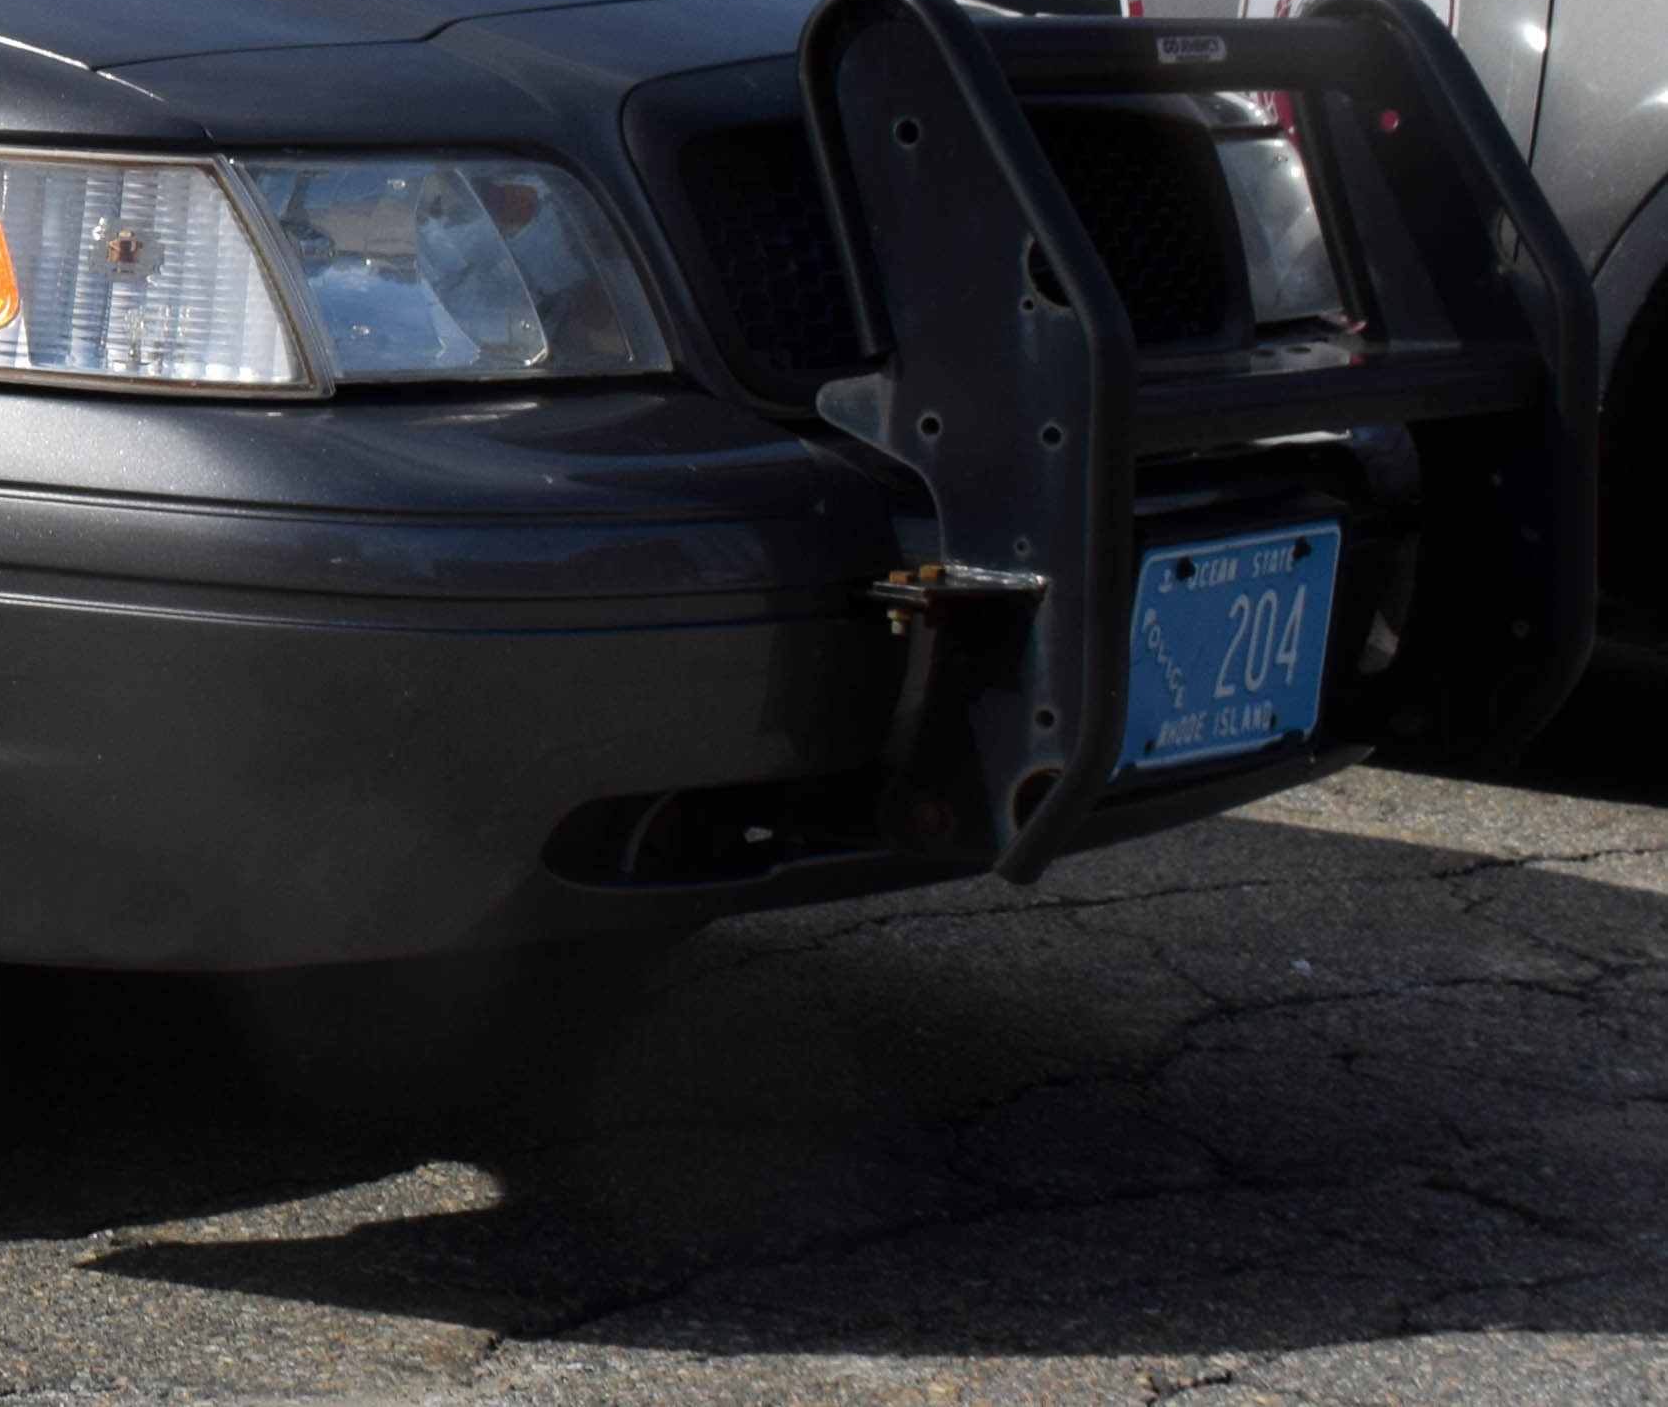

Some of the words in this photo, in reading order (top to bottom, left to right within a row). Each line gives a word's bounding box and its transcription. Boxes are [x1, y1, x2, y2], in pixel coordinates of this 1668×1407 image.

[1252, 545, 1296, 578] STATE
[1141, 607, 1185, 710] POLICE
[1214, 585, 1307, 699] 204
[1155, 710, 1208, 749] RHODE
[1212, 700, 1274, 737] ISLAND
